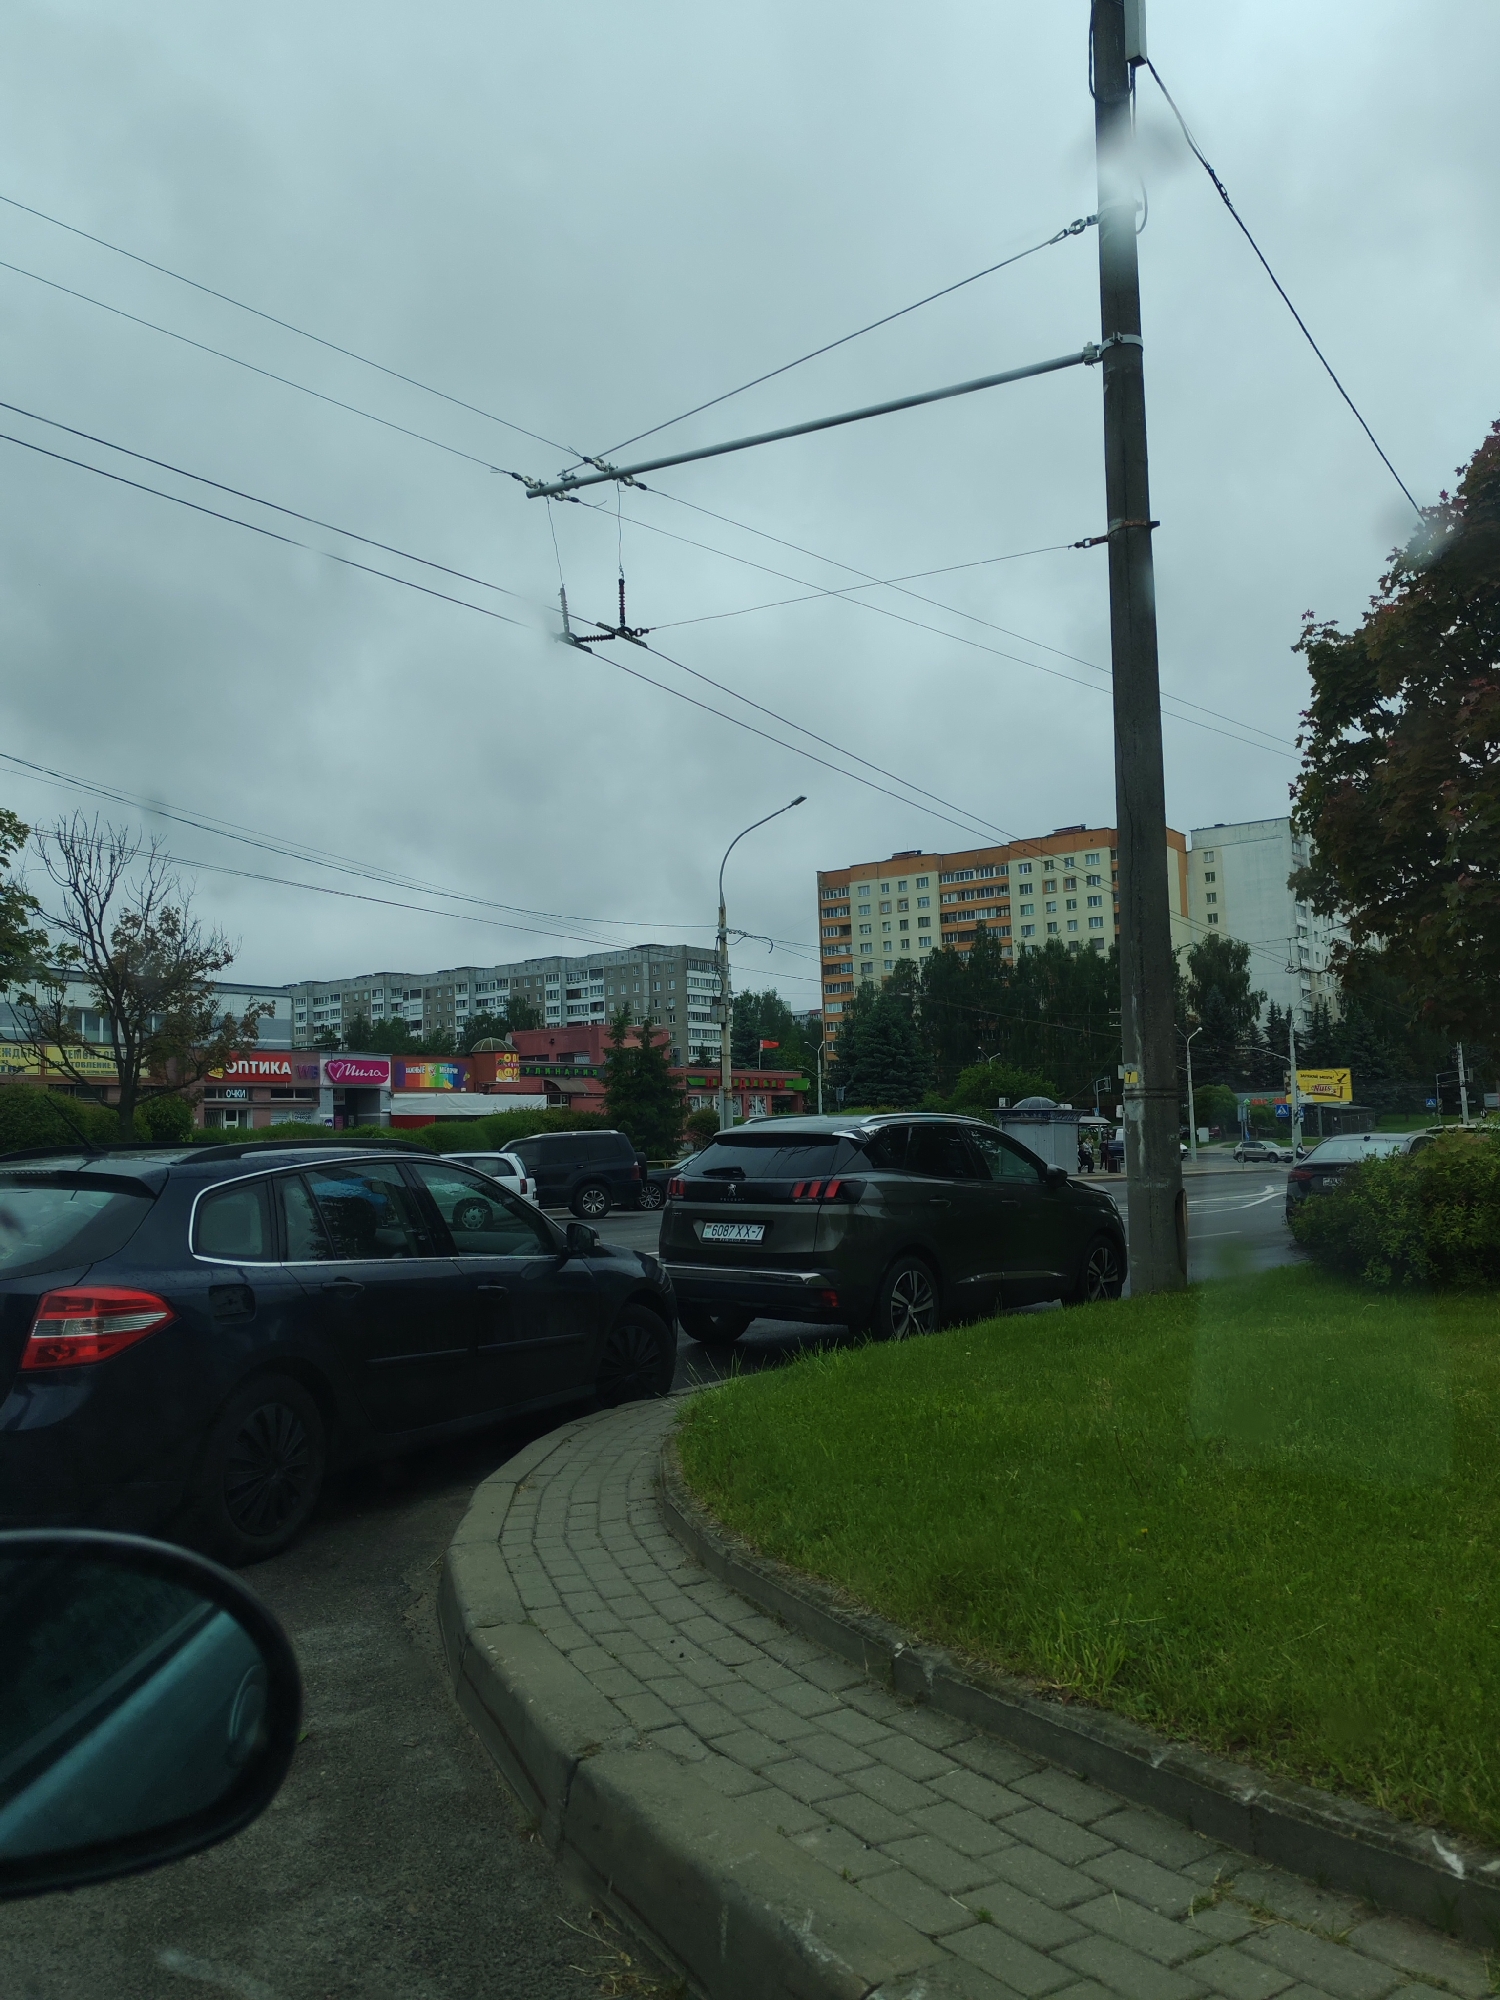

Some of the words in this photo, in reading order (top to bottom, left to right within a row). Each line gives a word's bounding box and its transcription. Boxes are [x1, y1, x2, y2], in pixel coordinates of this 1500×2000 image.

[226, 1060, 292, 1075] ОПТИКА
[341, 1062, 389, 1078] Мила
[525, 1067, 599, 1077] УЛИНАРИЯ
[225, 1089, 246, 1098] ОЧКИ
